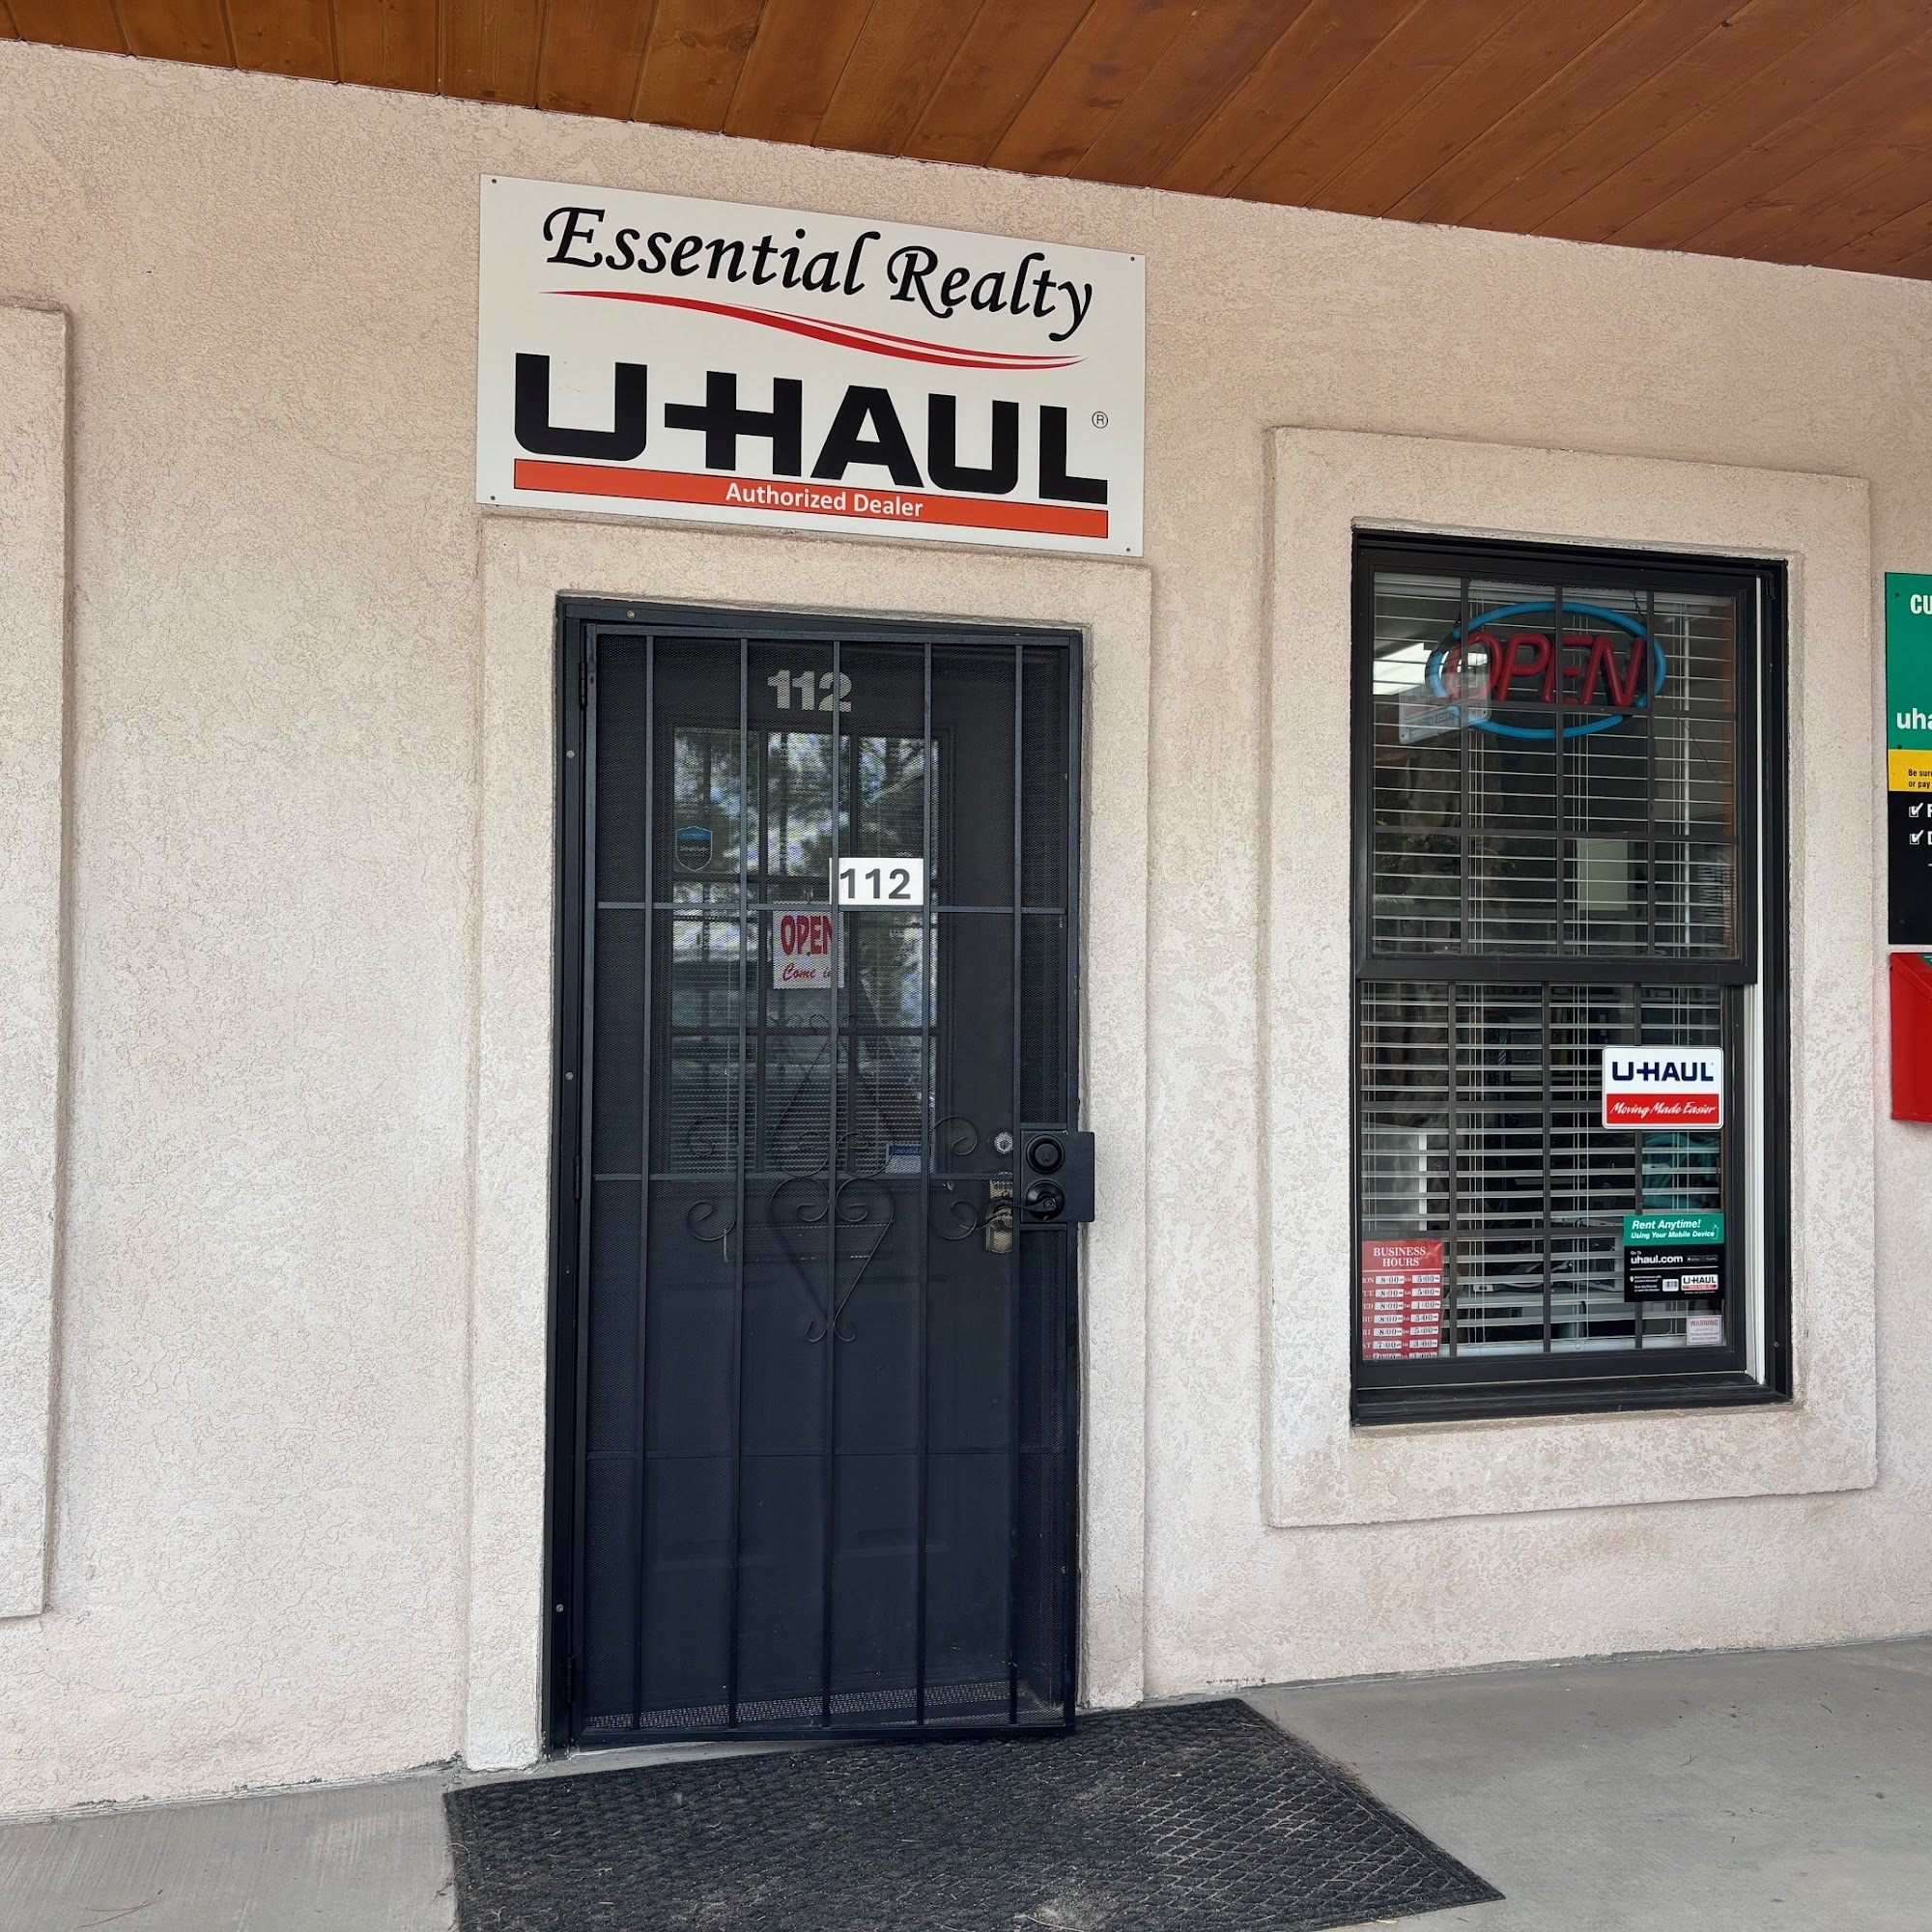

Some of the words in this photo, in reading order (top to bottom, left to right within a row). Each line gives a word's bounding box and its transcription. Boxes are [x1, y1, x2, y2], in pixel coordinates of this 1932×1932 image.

[542, 206, 881, 296] Essential
[886, 245, 1094, 342] Realty
[725, 482, 847, 512] Authorized
[853, 495, 923, 519] Dealer
[1449, 632, 1648, 707] OPEN
[767, 669, 853, 713] 112
[1908, 768, 1918, 777] Be
[840, 867, 911, 900] 112
[1610, 1101, 1651, 1119] Moving
[1650, 1101, 1682, 1115] Made
[1683, 1101, 1717, 1115] Easier
[1632, 1219, 1656, 1230] Rent
[1658, 1219, 1701, 1231] Anytime!
[1374, 1246, 1427, 1257] BUSINESS
[1631, 1254, 1684, 1264] uhaul.com
[1382, 1258, 1420, 1267] HOURS
